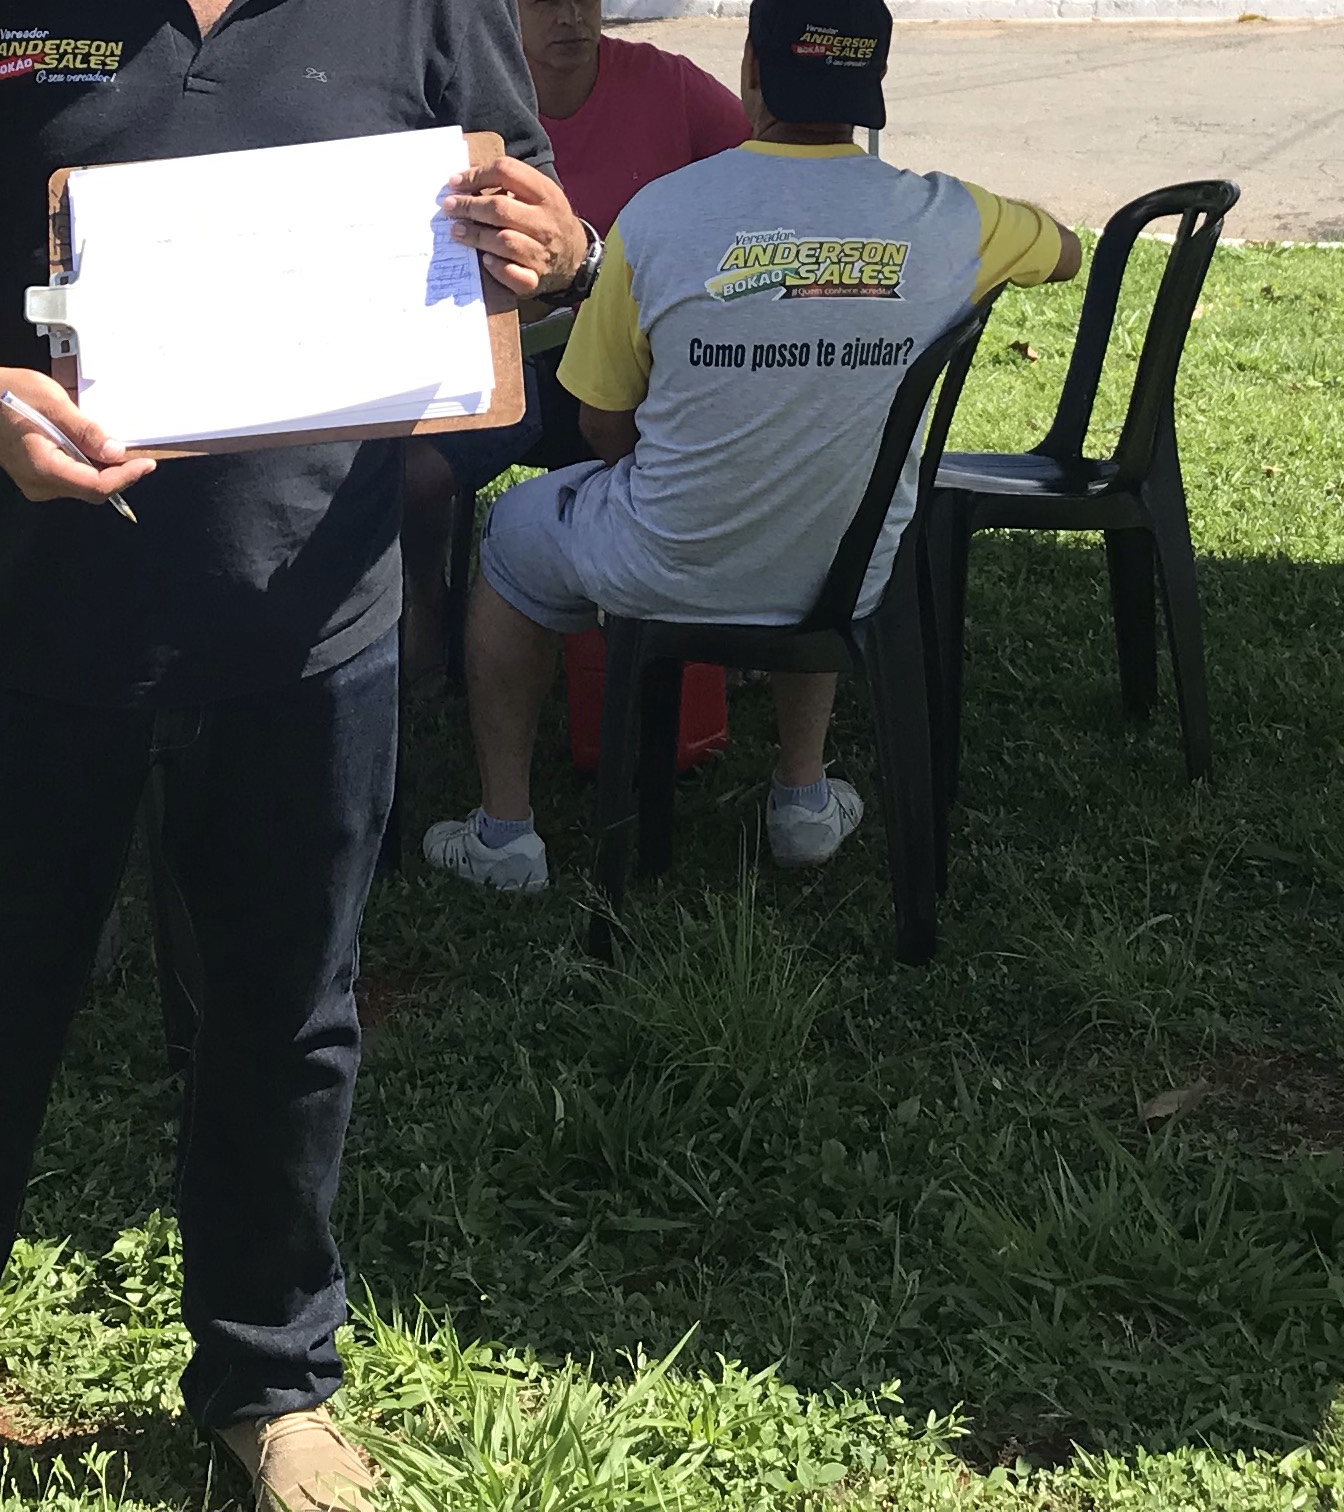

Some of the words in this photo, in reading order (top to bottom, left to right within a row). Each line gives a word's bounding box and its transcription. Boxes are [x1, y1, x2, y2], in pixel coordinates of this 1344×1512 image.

[799, 32, 878, 49] ANDERSON
[830, 46, 874, 58] SALES
[38, 54, 120, 70] SALES
[734, 229, 795, 246] Vereador
[720, 240, 908, 271] ANDERSON
[793, 263, 902, 286] SALES
[689, 338, 747, 368] Como
[751, 341, 811, 372] posso
[816, 338, 836, 367] te
[841, 336, 915, 370] ajudar?
